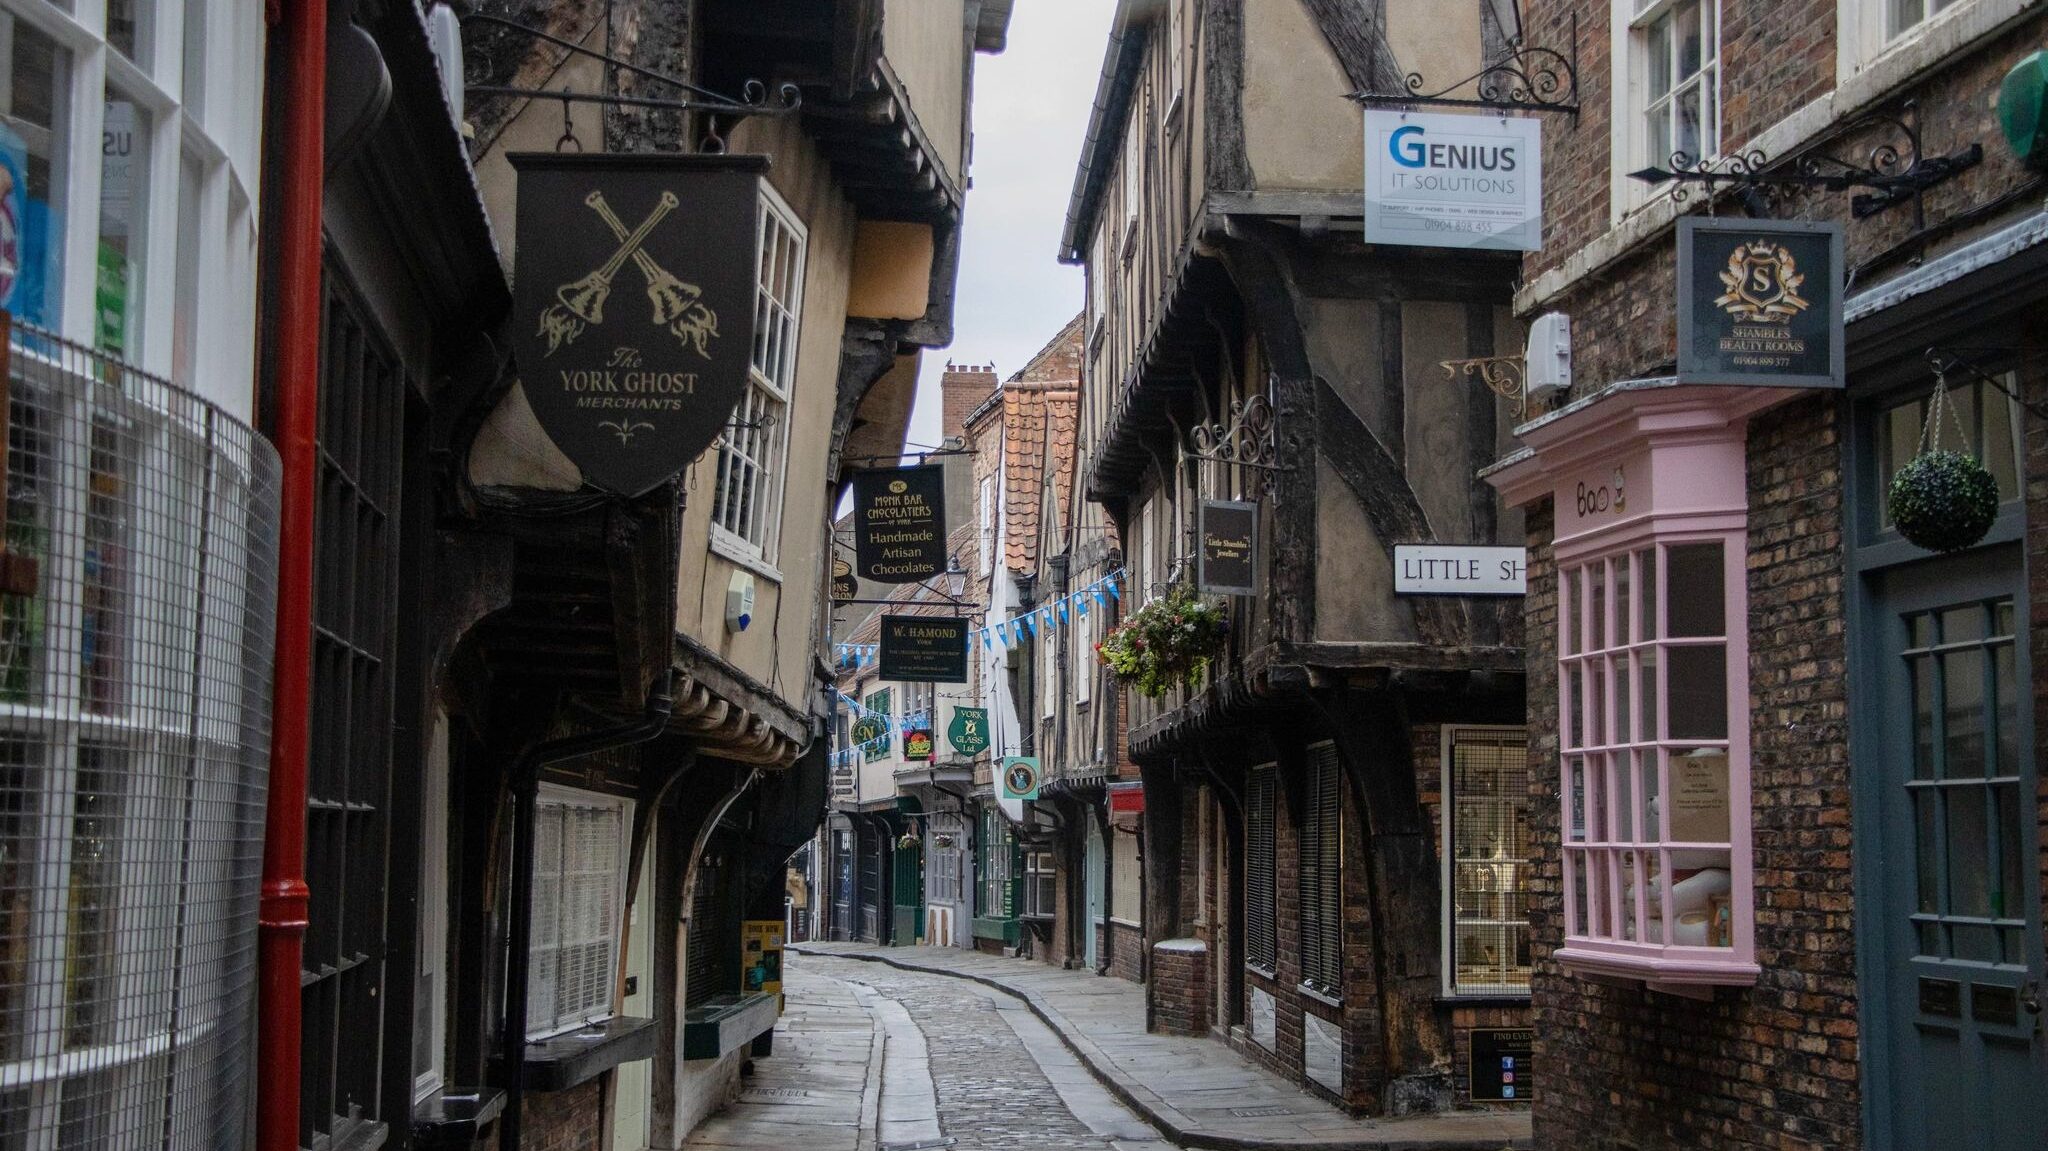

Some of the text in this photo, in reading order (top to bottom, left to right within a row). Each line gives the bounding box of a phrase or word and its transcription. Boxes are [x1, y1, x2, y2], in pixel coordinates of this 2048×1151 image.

[1389, 125, 1516, 172] GENIUS
[1392, 172, 1515, 194] IT SOLUTIONS
[1424, 219, 1451, 231] 01904
[1476, 221, 1492, 233] 455
[1753, 266, 1770, 292] S
[1732, 327, 1791, 339] SHAMBLES
[1719, 339, 1804, 352] BEAUTY ROOMS
[606, 346, 643, 368] The
[560, 370, 698, 394] YORK GHOST
[576, 397, 682, 411] MERCHANTS
[875, 494, 922, 507] MONK BAR
[867, 505, 932, 519] CHOCOLATIERS
[870, 530, 933, 544] Handmade
[882, 547, 922, 559] Artisan
[871, 561, 935, 575] Chocolates
[1404, 559, 1480, 580] LITTLE
[893, 625, 957, 639] W. HAMOND
[960, 710, 982, 720] YORK
[955, 735, 983, 745] GLASS
